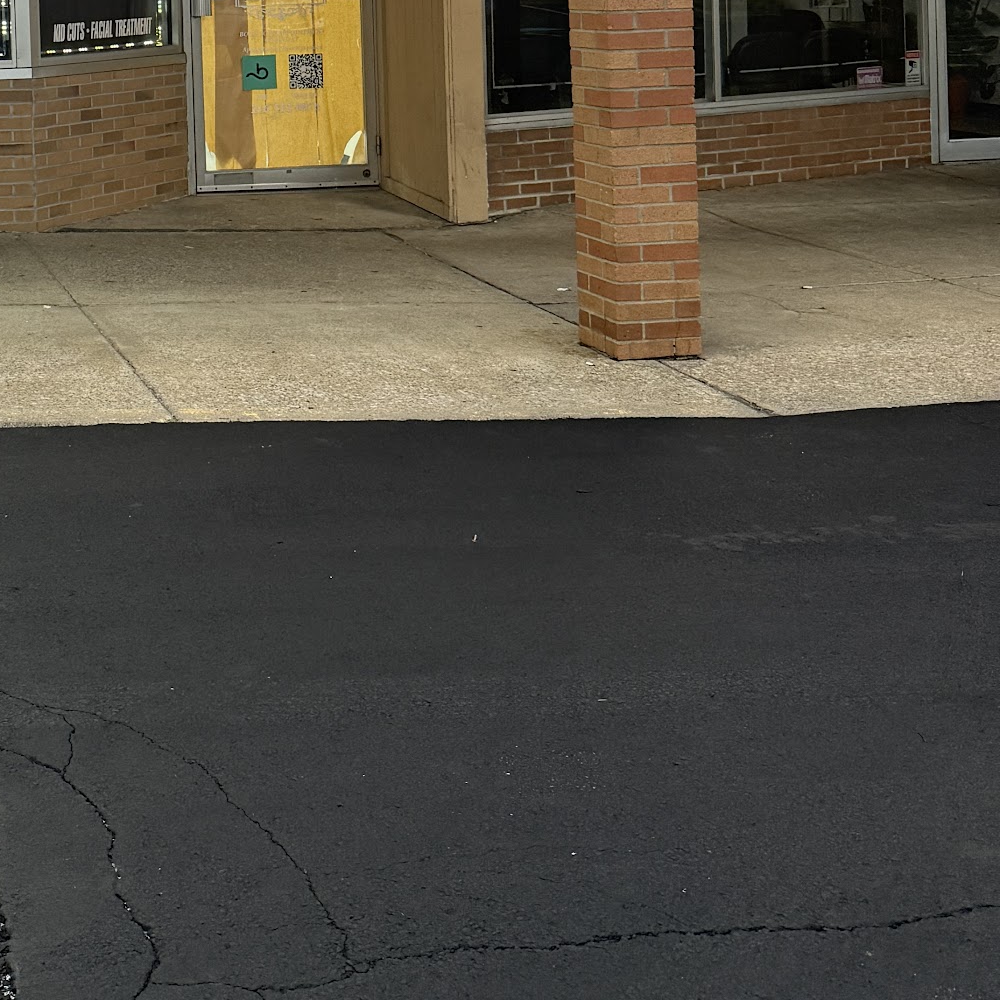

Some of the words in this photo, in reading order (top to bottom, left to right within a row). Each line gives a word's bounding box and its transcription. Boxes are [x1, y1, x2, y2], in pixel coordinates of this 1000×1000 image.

[53, 23, 66, 43] KID
[66, 21, 86, 42] CUTS
[90, 20, 113, 39] FACIAL
[114, 17, 152, 37] TREATMENT
